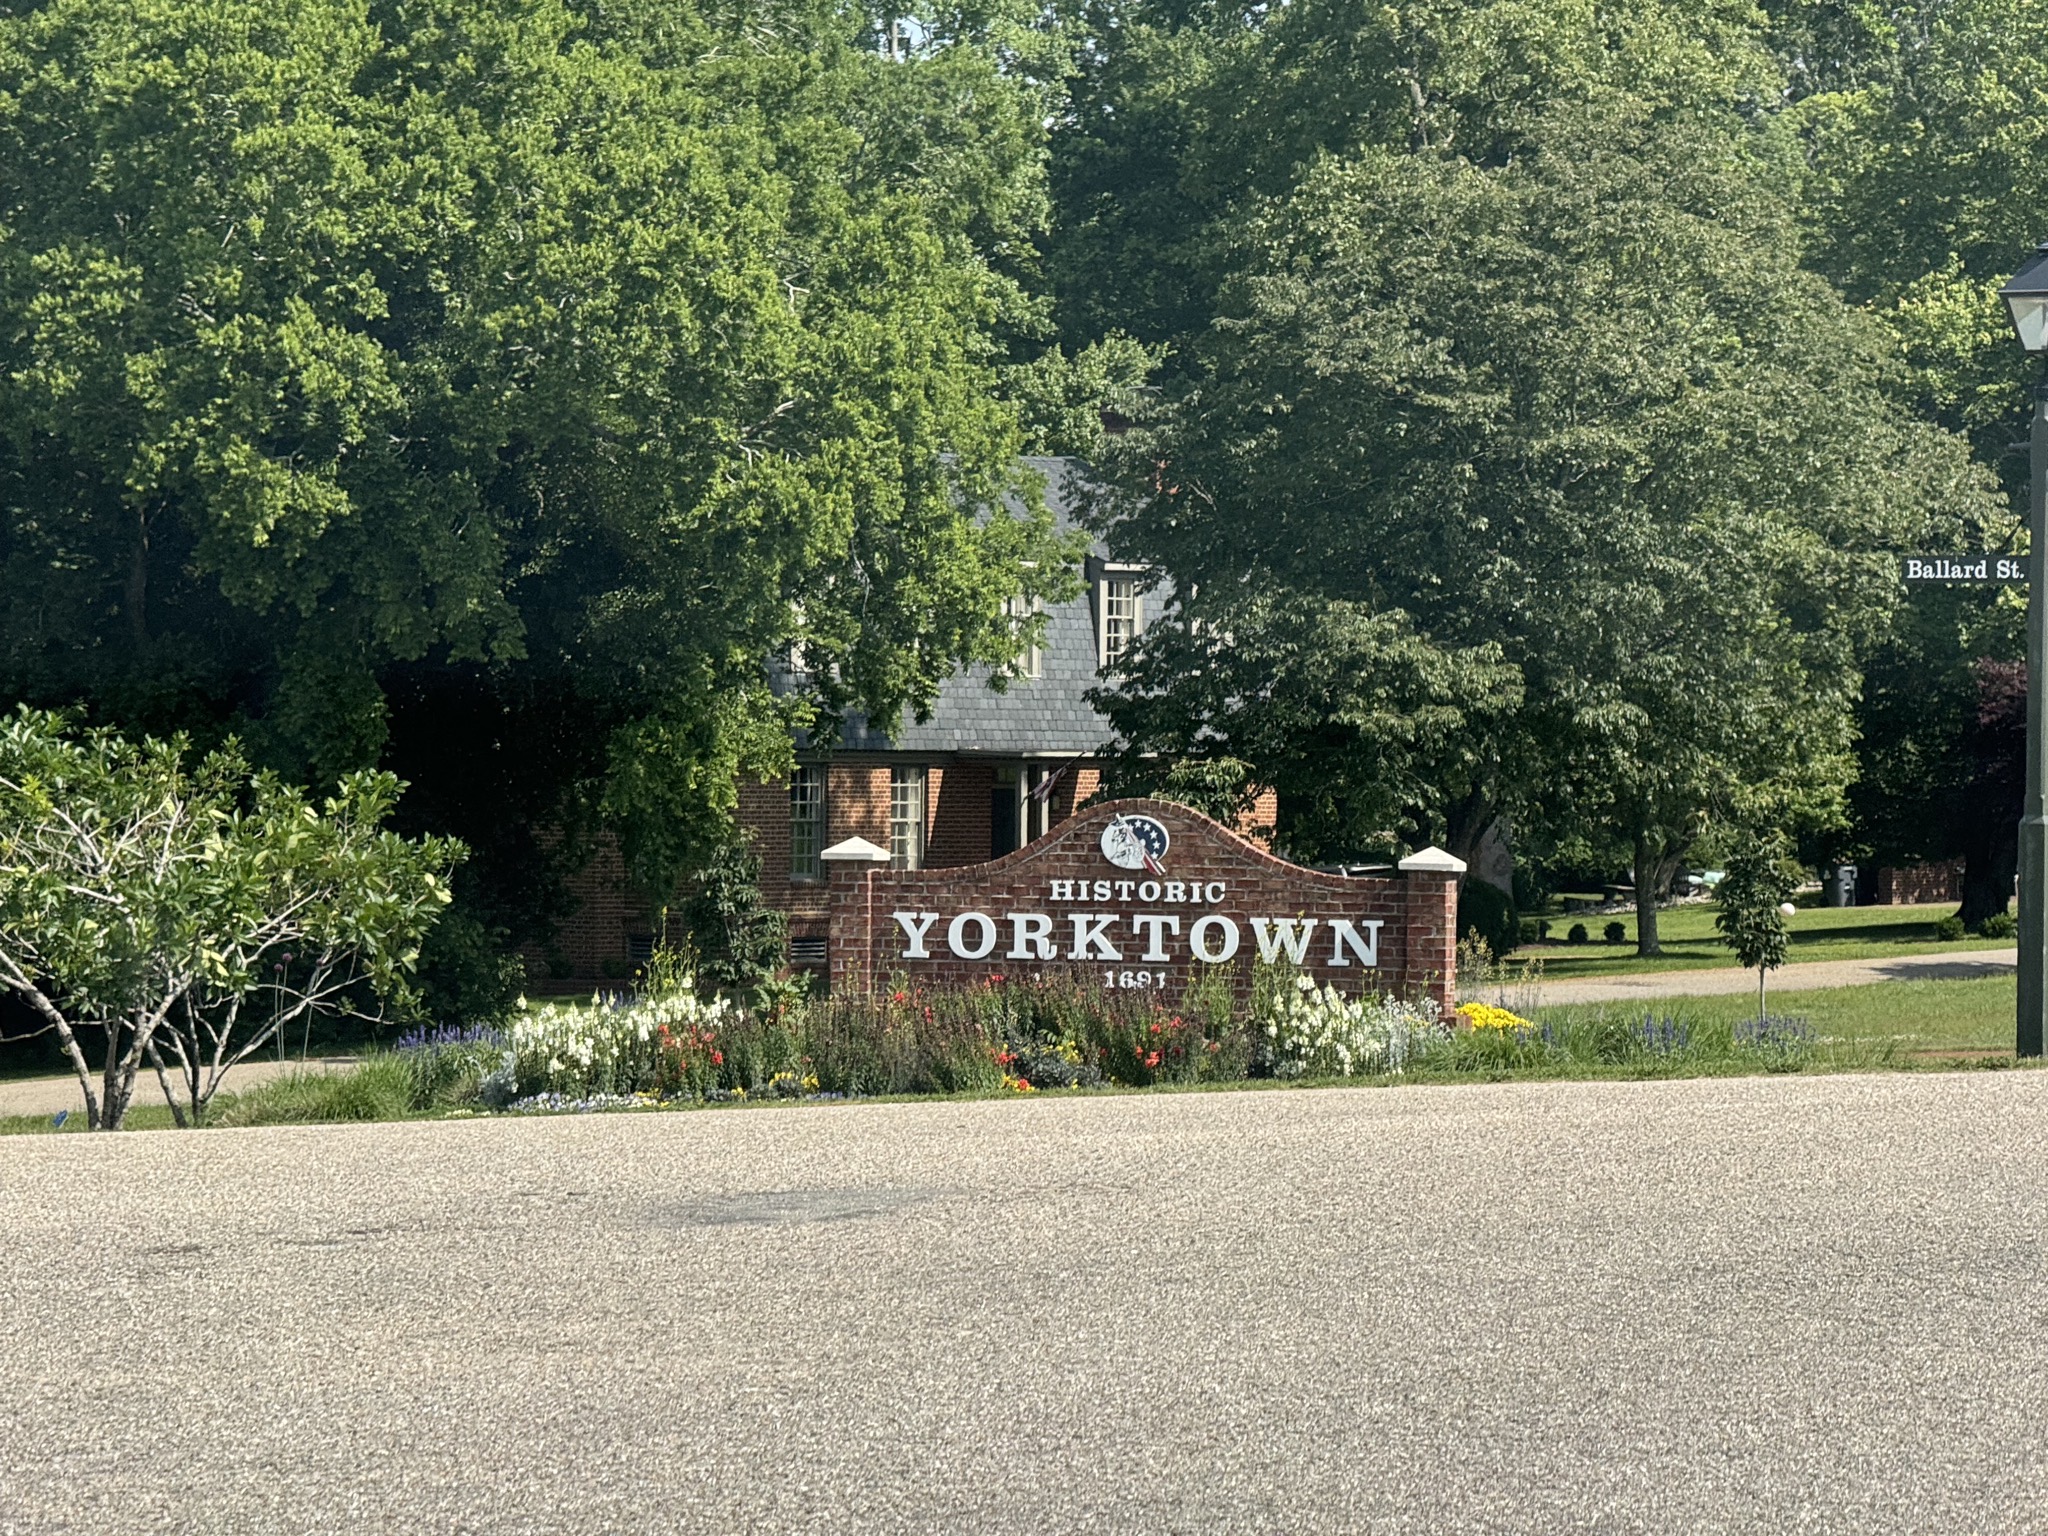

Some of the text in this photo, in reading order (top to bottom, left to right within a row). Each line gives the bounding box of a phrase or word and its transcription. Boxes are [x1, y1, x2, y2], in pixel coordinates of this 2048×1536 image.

[1906, 559, 2026, 580] Ballard St.
[1049, 879, 1227, 904] HISTORIC
[892, 911, 1385, 968] YORKTOWN
[1104, 970, 1166, 990] 1691
